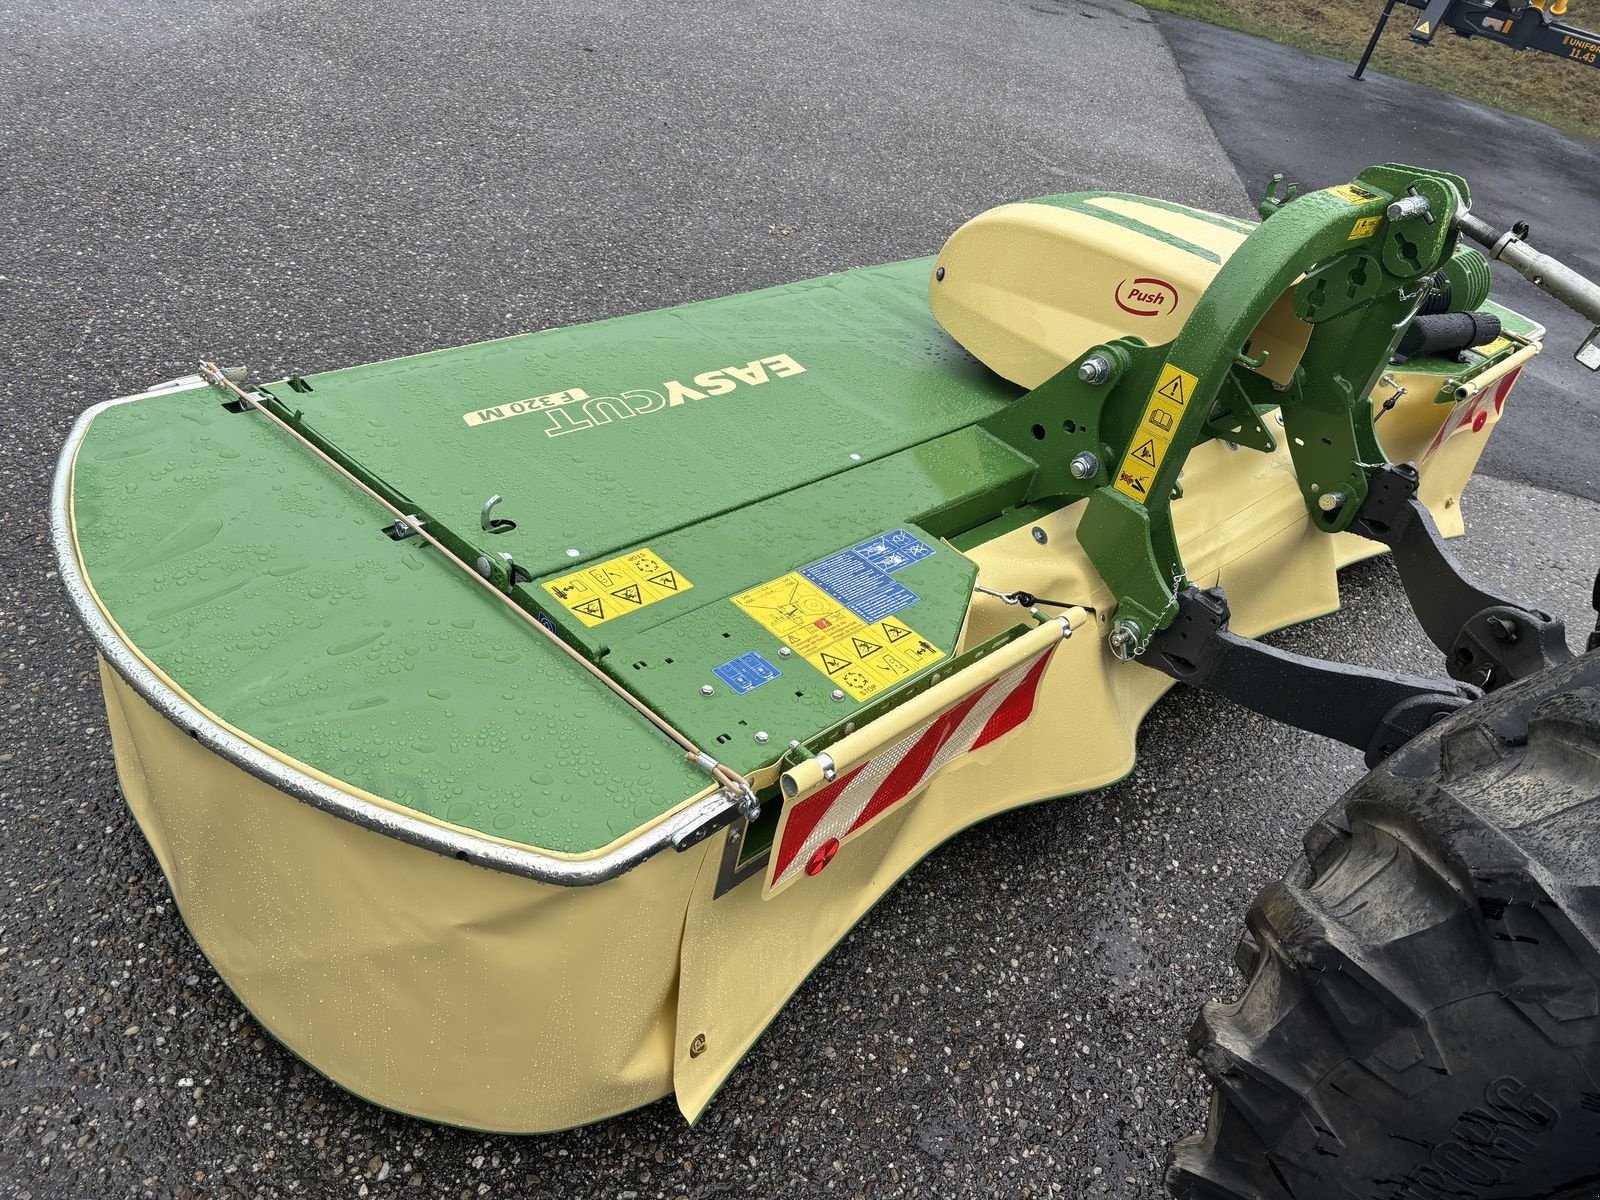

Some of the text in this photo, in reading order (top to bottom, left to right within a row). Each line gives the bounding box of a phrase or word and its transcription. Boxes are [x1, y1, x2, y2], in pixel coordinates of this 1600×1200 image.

[1569, 48, 1596, 63] 11.43
[1127, 288, 1165, 305] Push
[477, 392, 575, 422] F 320 M
[628, 553, 646, 562] STOP
[859, 684, 877, 696] STOP
